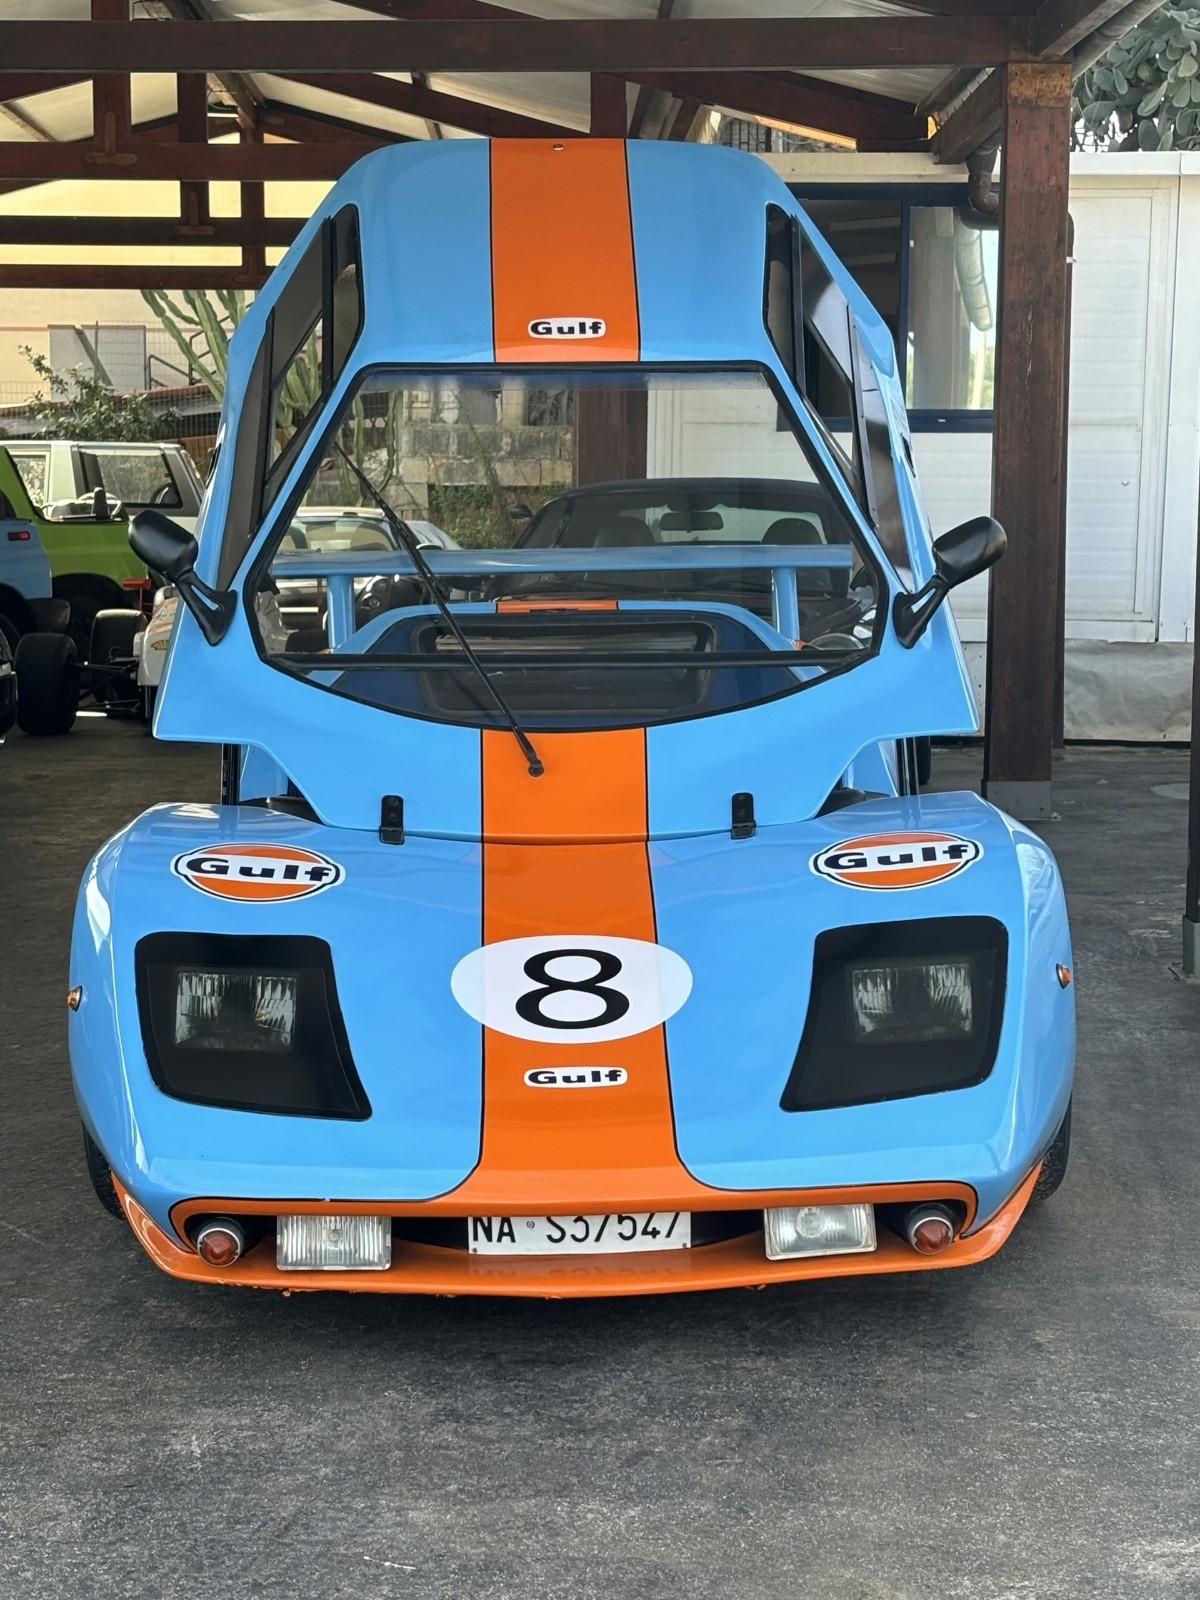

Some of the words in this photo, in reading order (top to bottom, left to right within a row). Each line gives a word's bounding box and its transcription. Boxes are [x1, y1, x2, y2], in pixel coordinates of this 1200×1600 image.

[531, 321, 602, 336] Gulf
[186, 857, 332, 882] Gulf
[824, 844, 969, 870] Gulf
[515, 948, 630, 1030] 8
[528, 1070, 622, 1085] Gulf
[472, 1216, 516, 1243] NA
